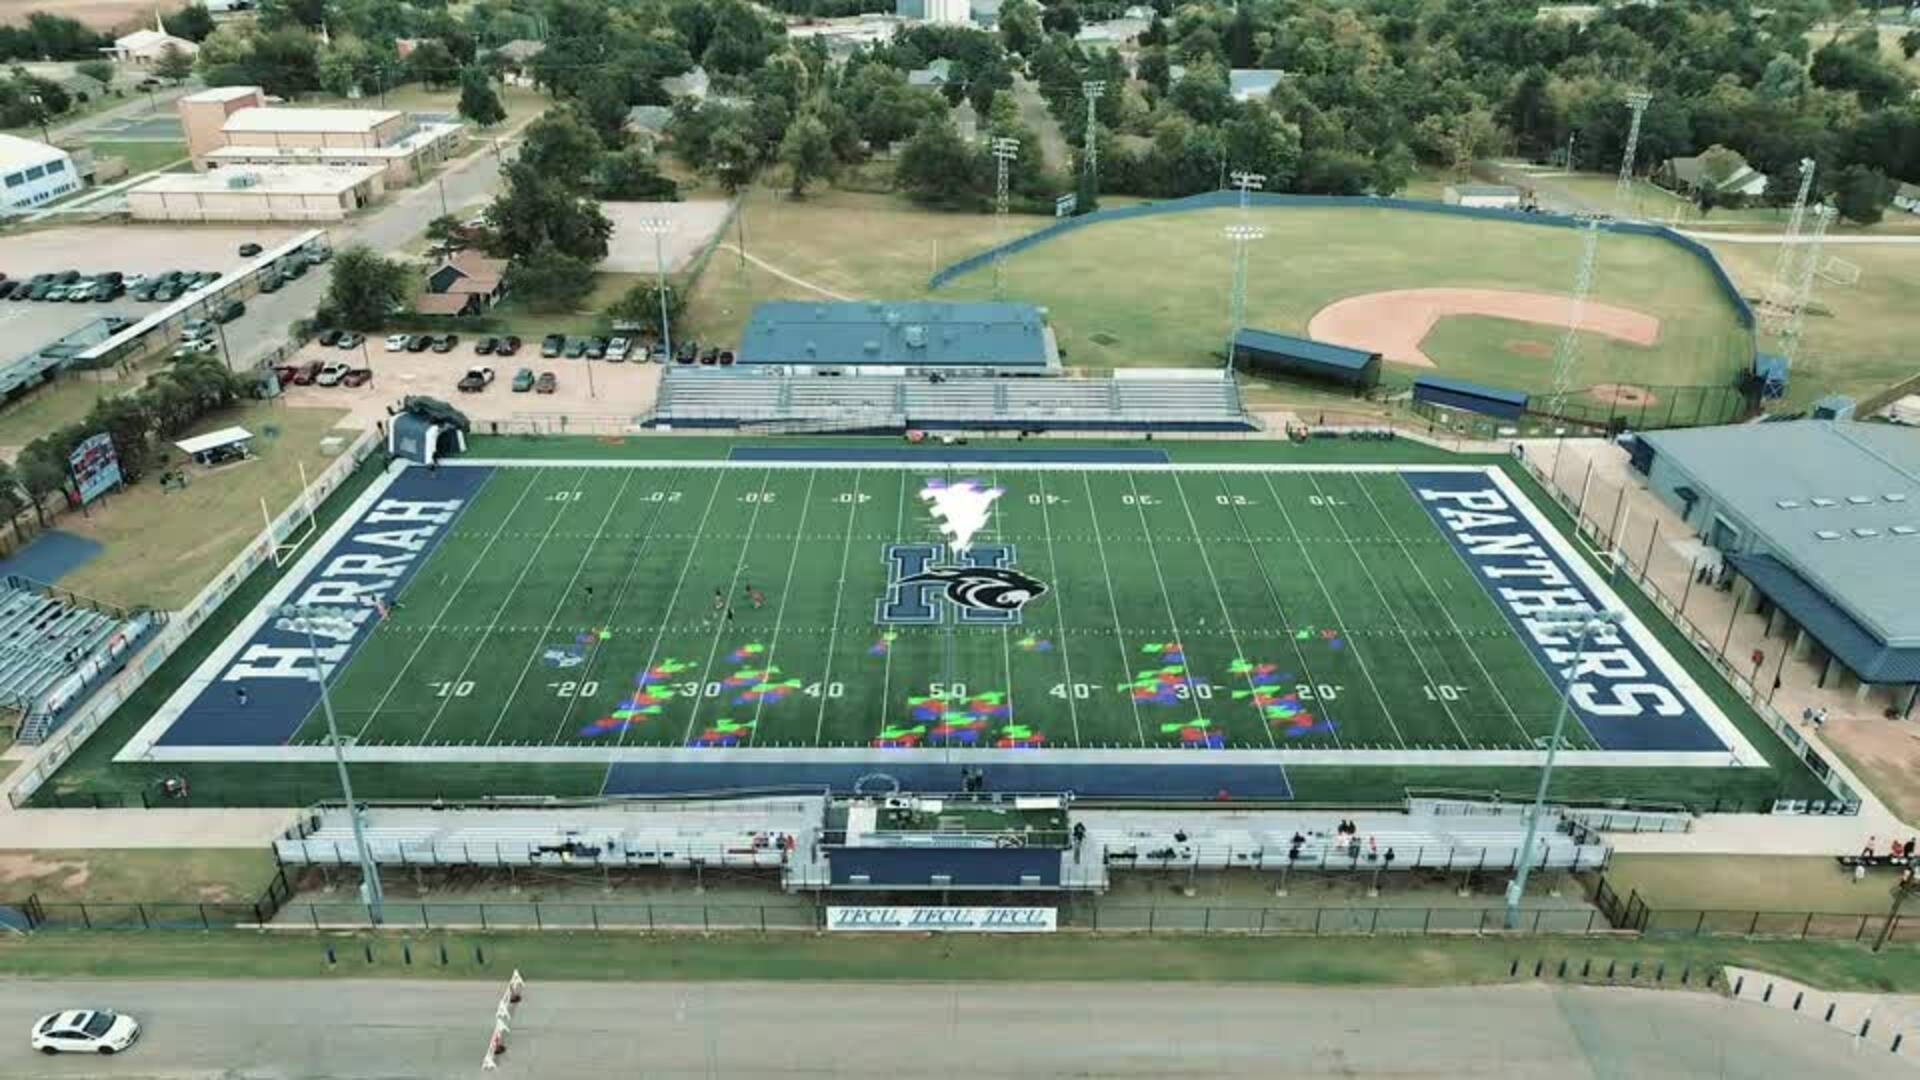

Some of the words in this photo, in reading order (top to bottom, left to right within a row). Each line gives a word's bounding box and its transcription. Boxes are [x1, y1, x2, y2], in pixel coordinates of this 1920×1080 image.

[436, 681, 476, 698] 10
[556, 681, 600, 698] 20
[681, 681, 722, 698] 30
[803, 681, 844, 698] 40
[928, 682, 967, 699] 50
[1049, 682, 1090, 699] 40
[1175, 683, 1213, 700] 30
[1295, 684, 1337, 700] 20
[1423, 684, 1459, 701] 10
